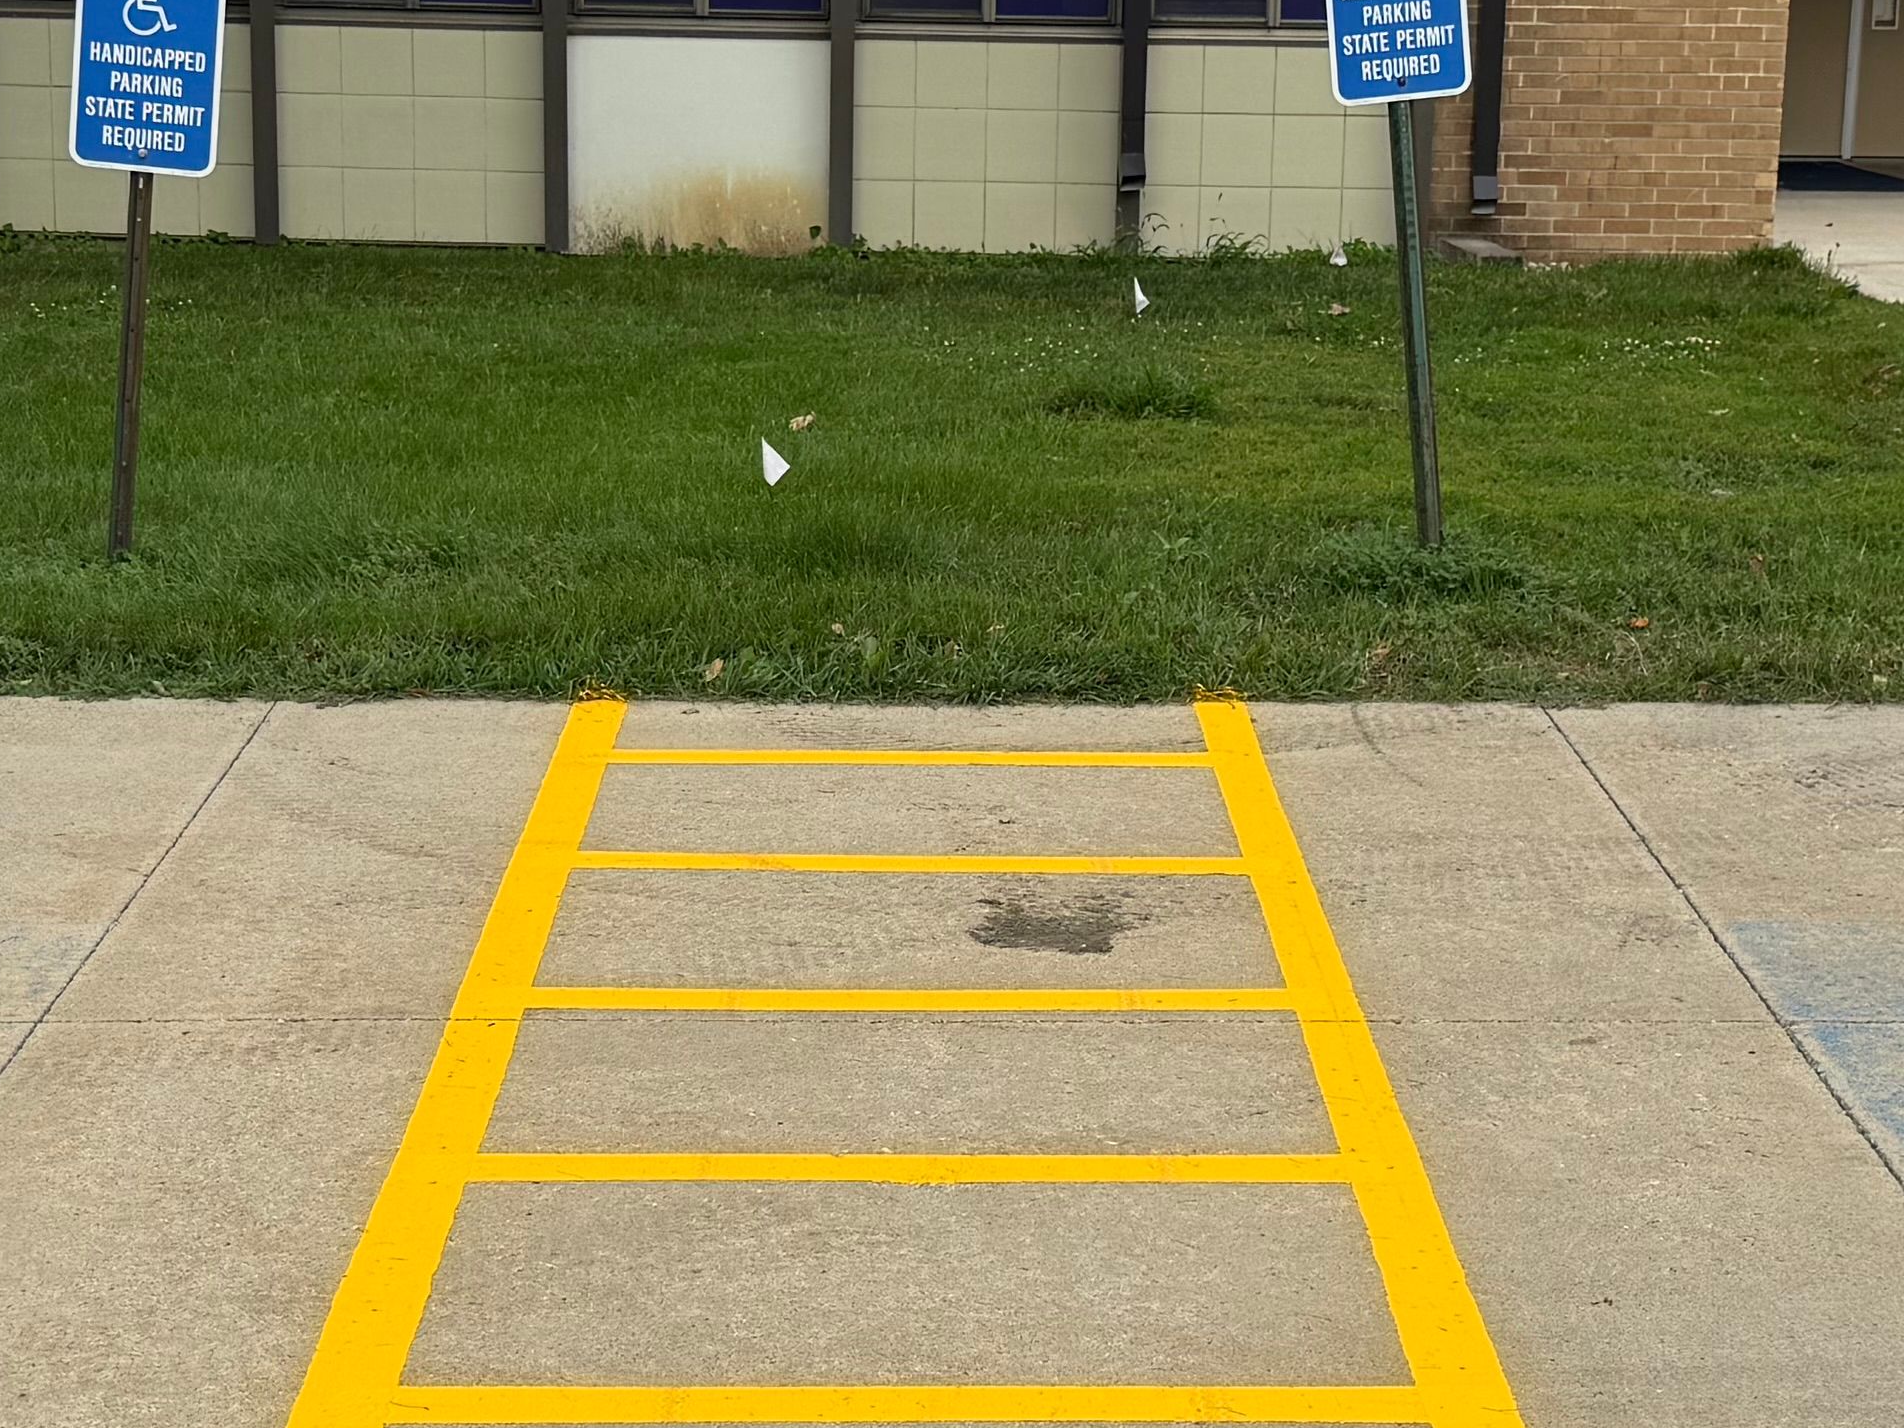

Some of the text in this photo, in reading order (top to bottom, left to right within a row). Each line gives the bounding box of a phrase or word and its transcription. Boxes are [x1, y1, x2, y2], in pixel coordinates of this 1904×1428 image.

[1362, 0, 1432, 27] PARKING
[1342, 24, 1455, 56] STATE PERMIT
[89, 41, 206, 73] HANDICAPPED
[1361, 53, 1441, 82] REQUIRED
[110, 70, 183, 98] PARKING
[85, 95, 206, 127] STATE PERMIT
[102, 124, 185, 152] REQUIRED
